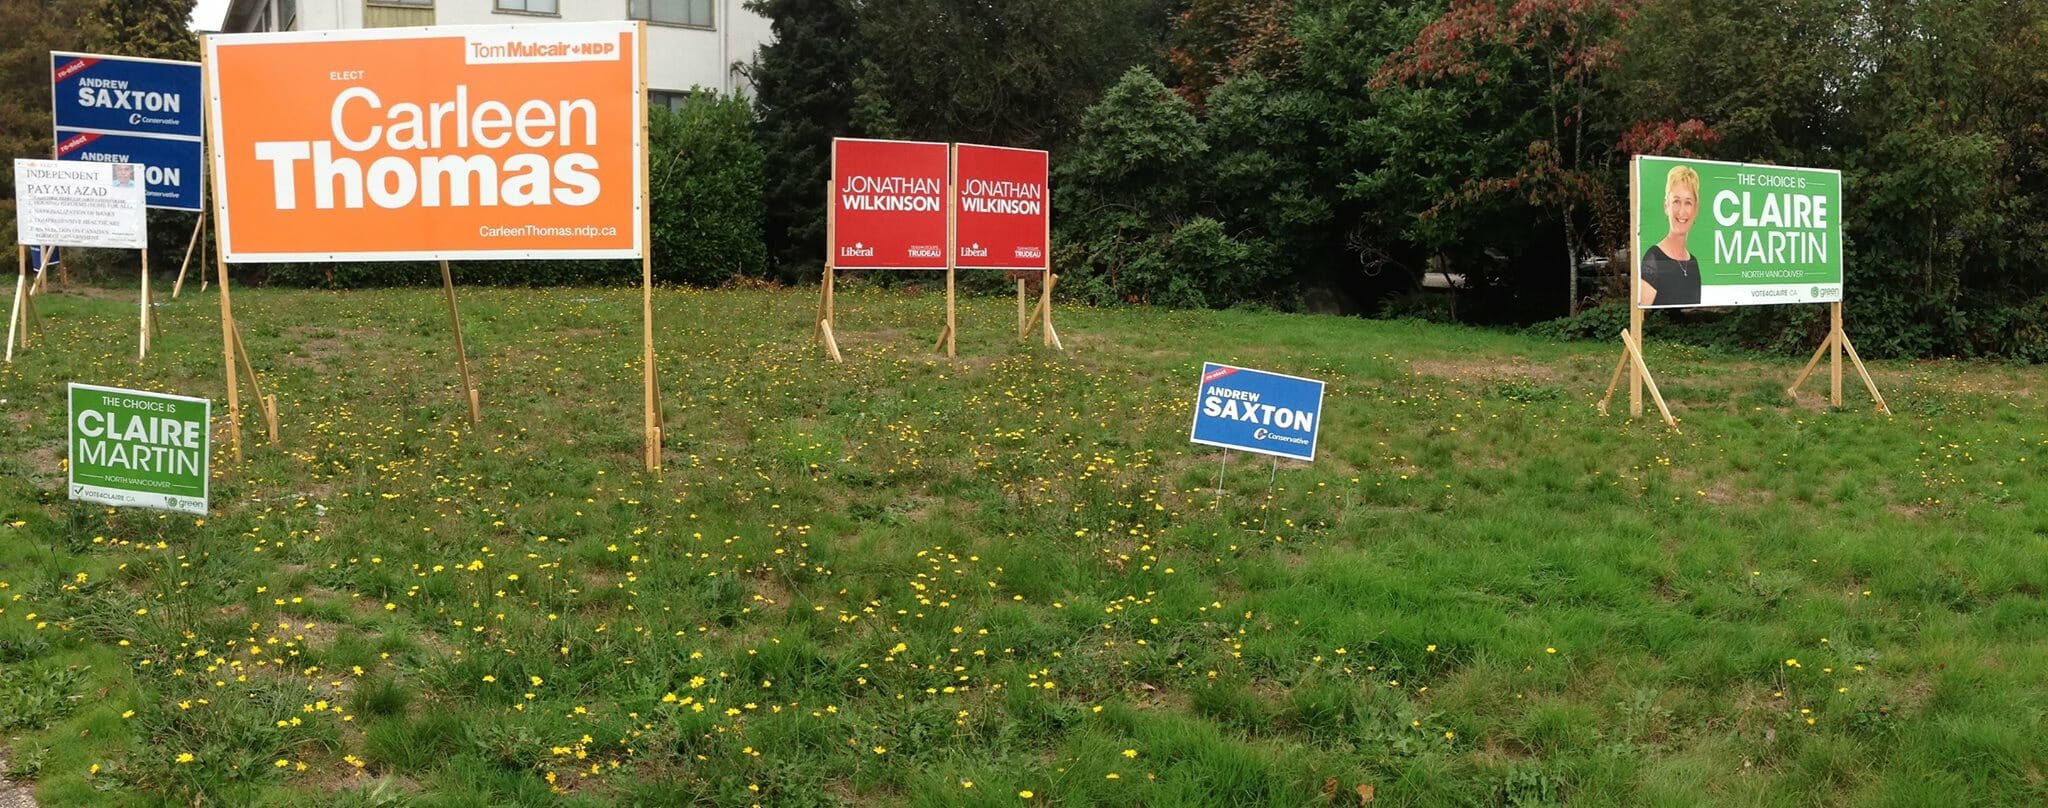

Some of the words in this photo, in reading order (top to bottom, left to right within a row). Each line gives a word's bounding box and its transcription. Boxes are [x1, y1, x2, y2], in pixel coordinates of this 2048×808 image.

[470, 42, 505, 58] Tom
[507, 41, 571, 57] Mulcair
[581, 43, 615, 55] NDP
[57, 60, 86, 78] re-elect
[330, 70, 365, 81] ELECT
[78, 77, 129, 90] ANDREW
[78, 87, 181, 113] SAXTON
[142, 116, 181, 126] Conservative
[331, 84, 598, 152] Carleen
[60, 135, 88, 153] re-elect
[80, 152, 130, 164] ANDREW
[27, 169, 100, 181] INDEPENDENT
[254, 140, 601, 210] Thomas
[1737, 173, 1756, 186] THE
[1757, 174, 1796, 188] CHOICE
[1797, 177, 1806, 189] IS
[27, 184, 72, 195] PAYAM
[73, 186, 108, 197] AZAD
[842, 175, 941, 195] JONATHAN
[961, 179, 1041, 199] JONATHAN
[842, 194, 941, 212] WILKINSON
[961, 197, 1041, 216] WILKINSON
[1712, 189, 1827, 229] CLAIRE
[479, 224, 617, 239] CarleenThomas.ndp.ca
[841, 246, 874, 257] Liberal
[908, 249, 942, 257] TRUDEAU
[961, 246, 988, 257] Liberal
[1015, 250, 1041, 258] TRUDEAU
[1714, 230, 1827, 265] MARTIN
[1741, 270, 1764, 279] NORTH
[1764, 269, 1804, 278] VANCOUVER
[1819, 287, 1840, 298] green
[1205, 369, 1227, 381] re-elect
[1207, 386, 1260, 403] ANDREW
[102, 396, 120, 407] THE
[122, 399, 164, 412] CHOICE
[167, 403, 176, 413] IS
[1203, 395, 1313, 433] SAXTON
[77, 409, 200, 449] CLAIRE
[1267, 432, 1310, 446] Conservative
[79, 438, 199, 477] MARTIN
[104, 475, 128, 484] NORTH
[128, 478, 172, 488] VANCOUVER
[178, 499, 204, 509] green
